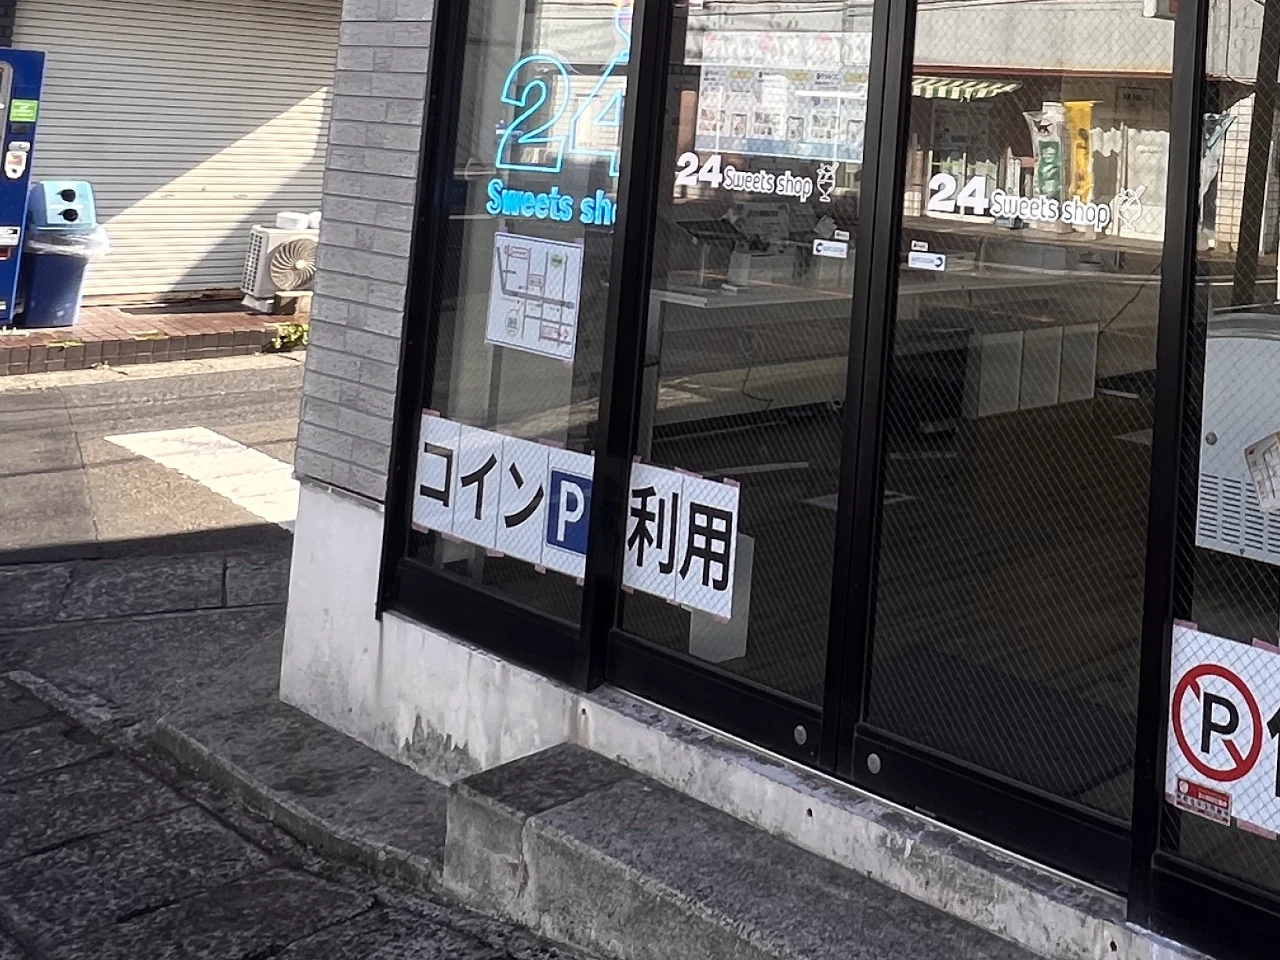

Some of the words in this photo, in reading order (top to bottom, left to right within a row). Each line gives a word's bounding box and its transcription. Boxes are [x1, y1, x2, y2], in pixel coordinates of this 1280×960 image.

[497, 53, 621, 178] 24
[486, 178, 573, 224] Sweets
[579, 189, 616, 226] sh
[676, 151, 723, 188] 24
[723, 164, 775, 195] Sweets
[775, 172, 813, 203] shop
[927, 172, 989, 215] 24
[990, 188, 1060, 223] Sweets
[1060, 195, 1112, 232] shop
